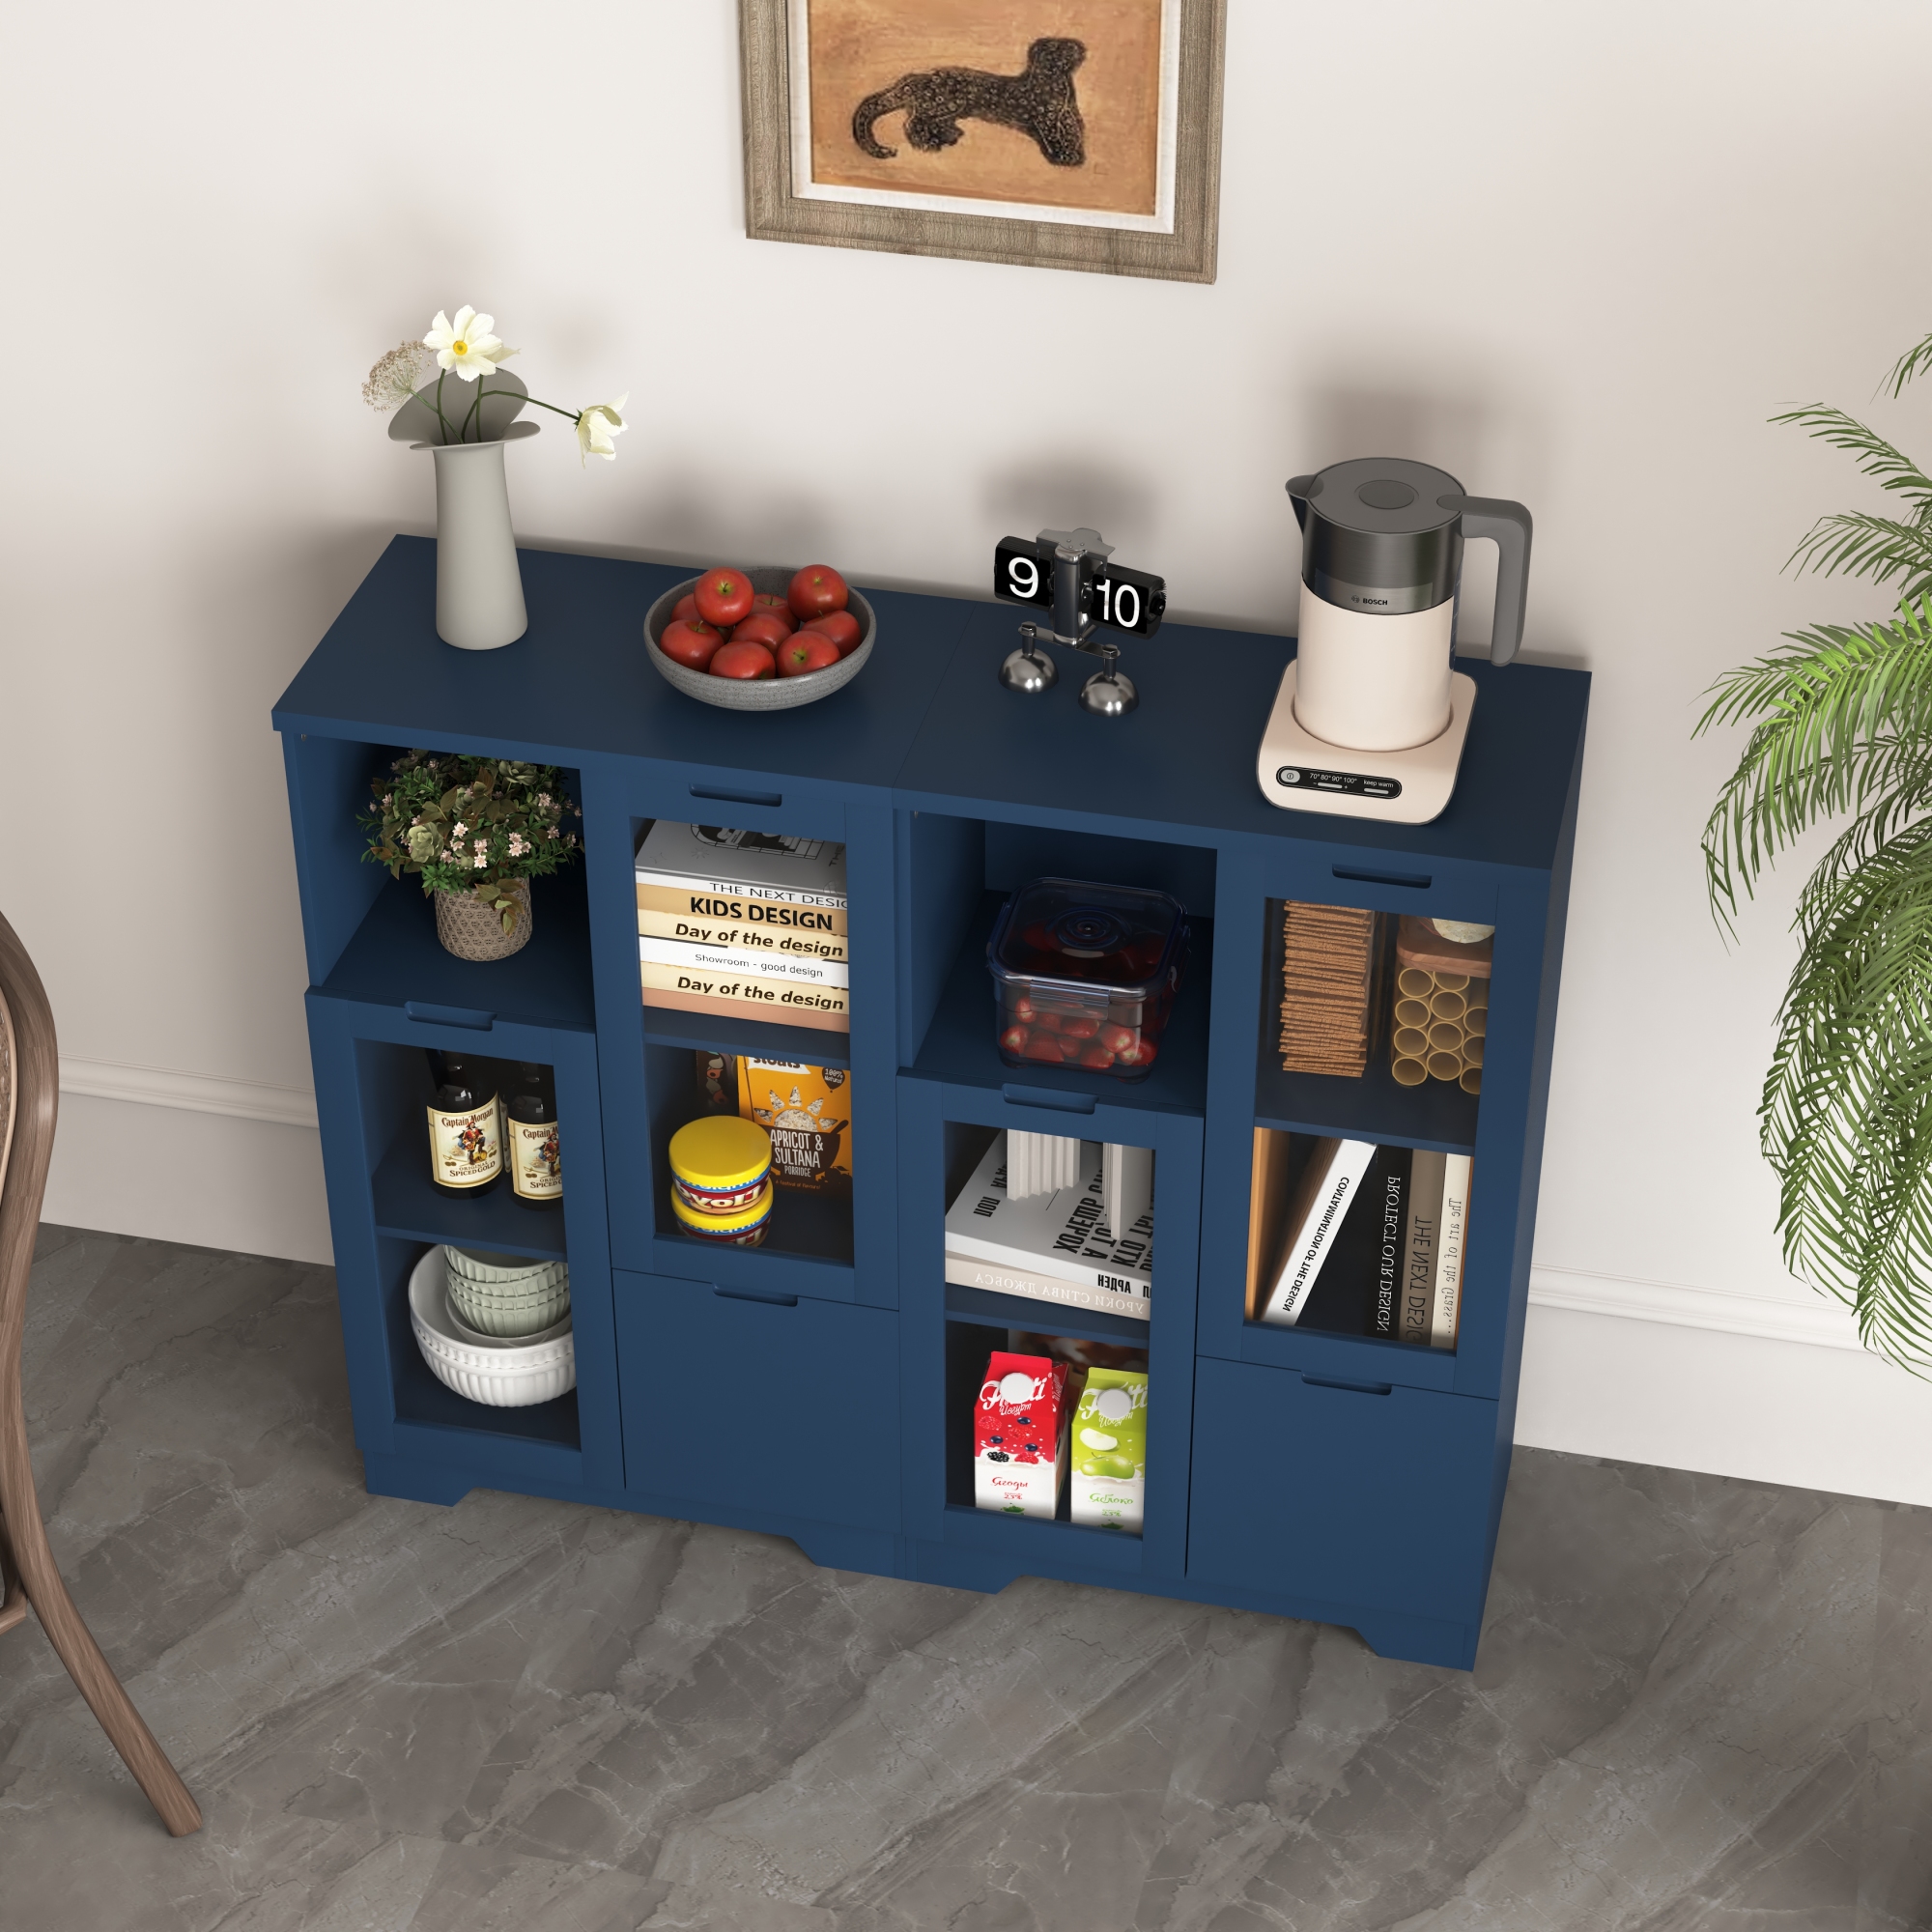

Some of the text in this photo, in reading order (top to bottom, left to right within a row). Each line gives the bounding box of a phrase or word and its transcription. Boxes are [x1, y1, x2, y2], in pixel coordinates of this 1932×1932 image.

[1008, 556, 1039, 598] 9
[1095, 579, 1140, 628] 10
[709, 882, 744, 895] THE
[750, 888, 796, 901] NEXT
[691, 896, 833, 931] KIDS DESIGN
[675, 923, 843, 957] Day of the design
[695, 953, 750, 968] Showroom
[760, 962, 786, 972] good
[789, 965, 824, 979] design
[677, 976, 844, 1010] Day of the design
[825, 1068, 843, 1079] 100%
[441, 1108, 494, 1128] Captain Morgan
[523, 1128, 551, 1140] Captain
[770, 1129, 823, 1151] APRICOT &
[775, 1147, 820, 1168] SULTANA
[449, 1160, 496, 1177] SPICED GOLD
[784, 1165, 810, 1177] PORRIDGE
[529, 1180, 557, 1189] SPICED
